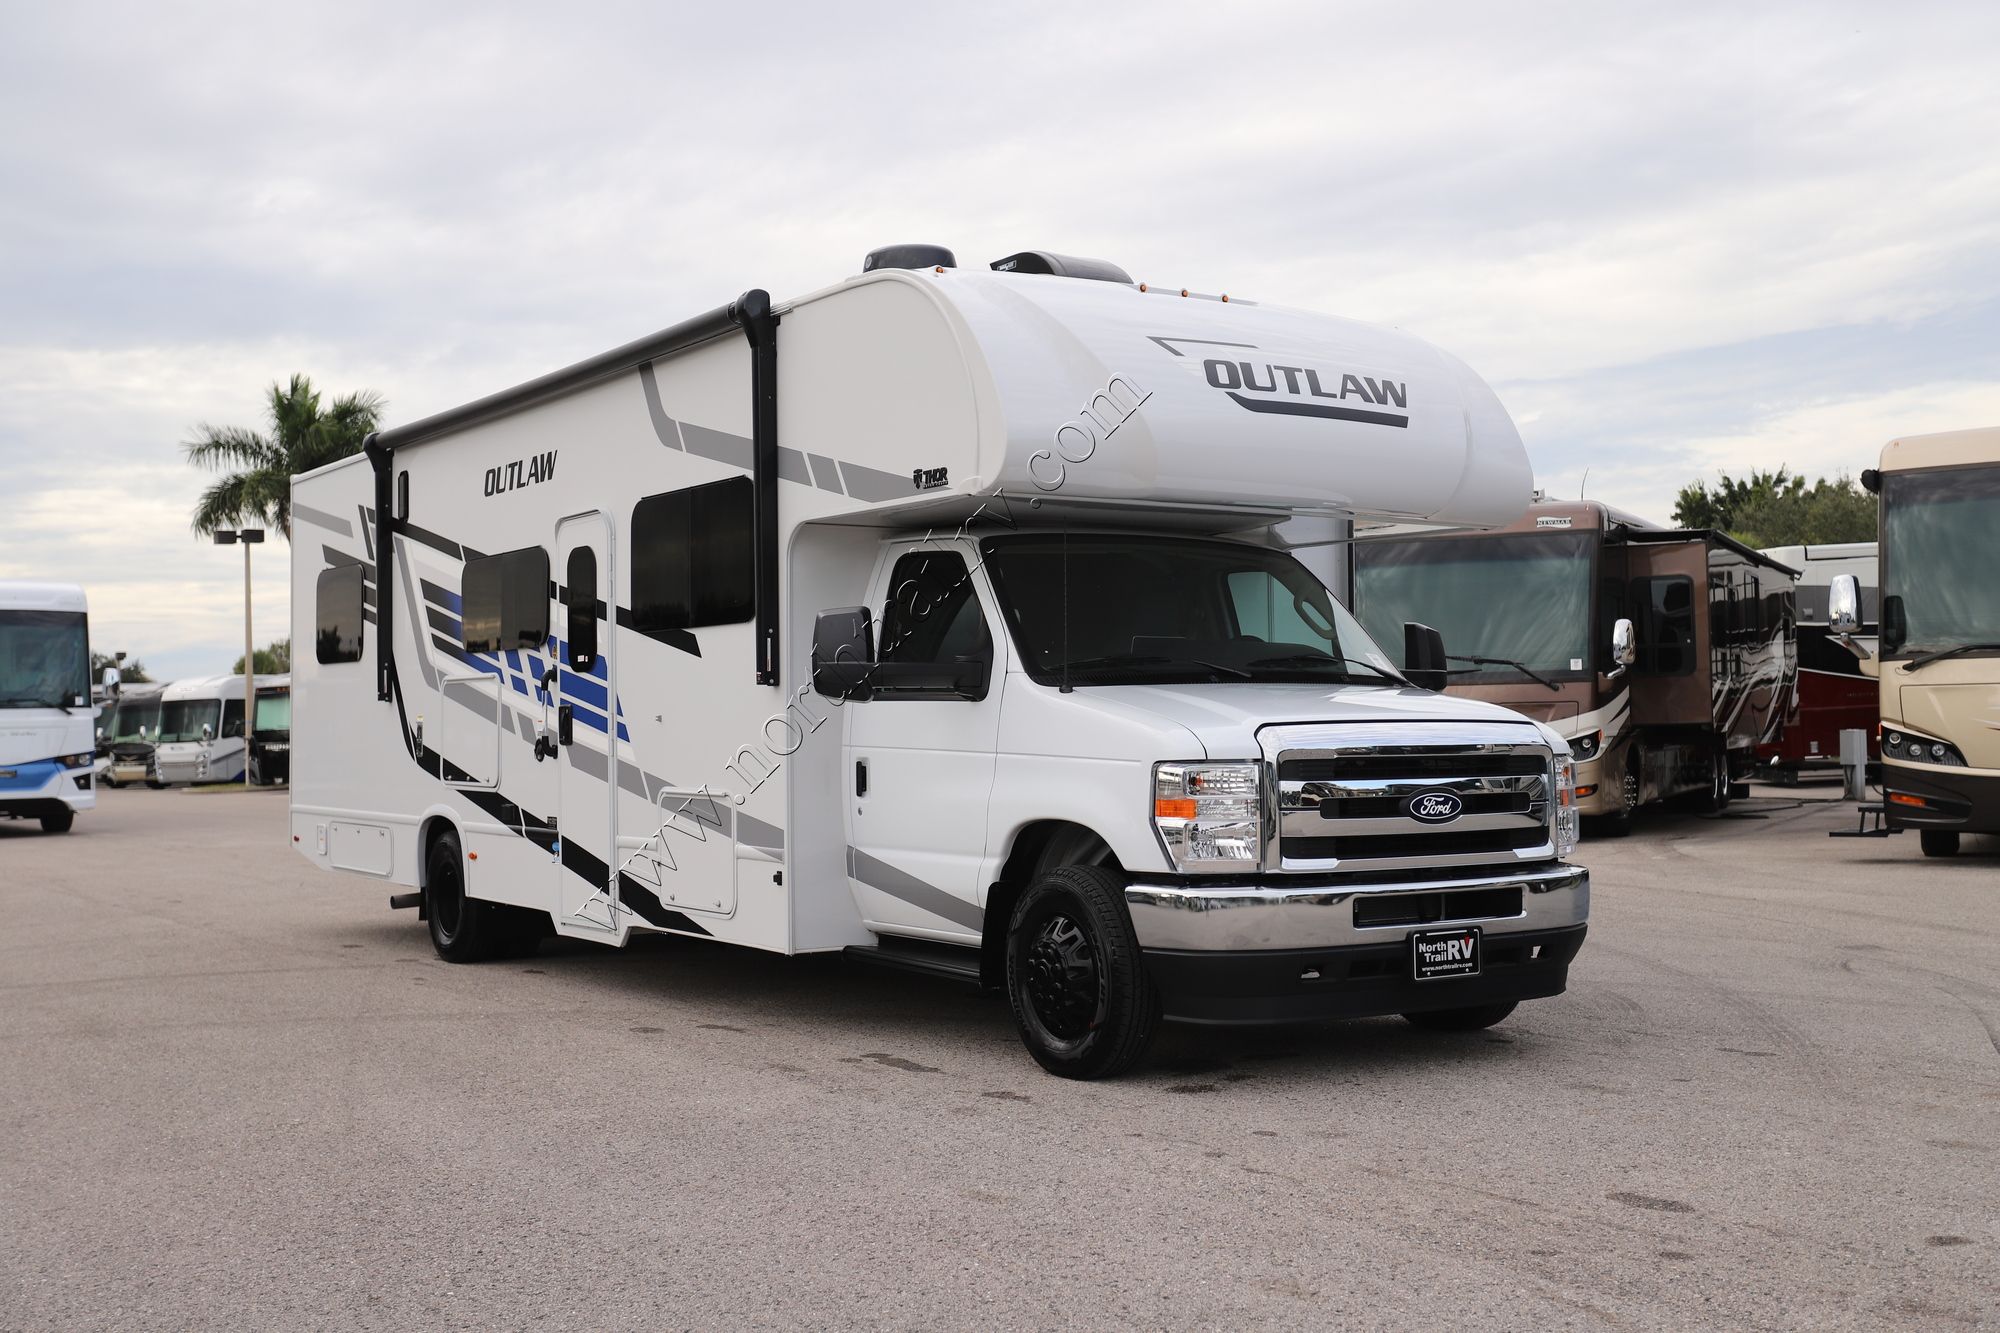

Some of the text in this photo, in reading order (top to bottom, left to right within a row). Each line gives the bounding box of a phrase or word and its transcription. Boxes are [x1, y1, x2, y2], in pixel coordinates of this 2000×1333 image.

[1203, 359, 1407, 408] OUTLAW
[484, 449, 558, 497] OUTLAW
[923, 467, 948, 484] THOR
[1420, 796, 1453, 815] Ford
[1418, 938, 1475, 961] North RV
[1424, 951, 1447, 963] Trail
[1421, 962, 1473, 972] www.northtrailrv.com
